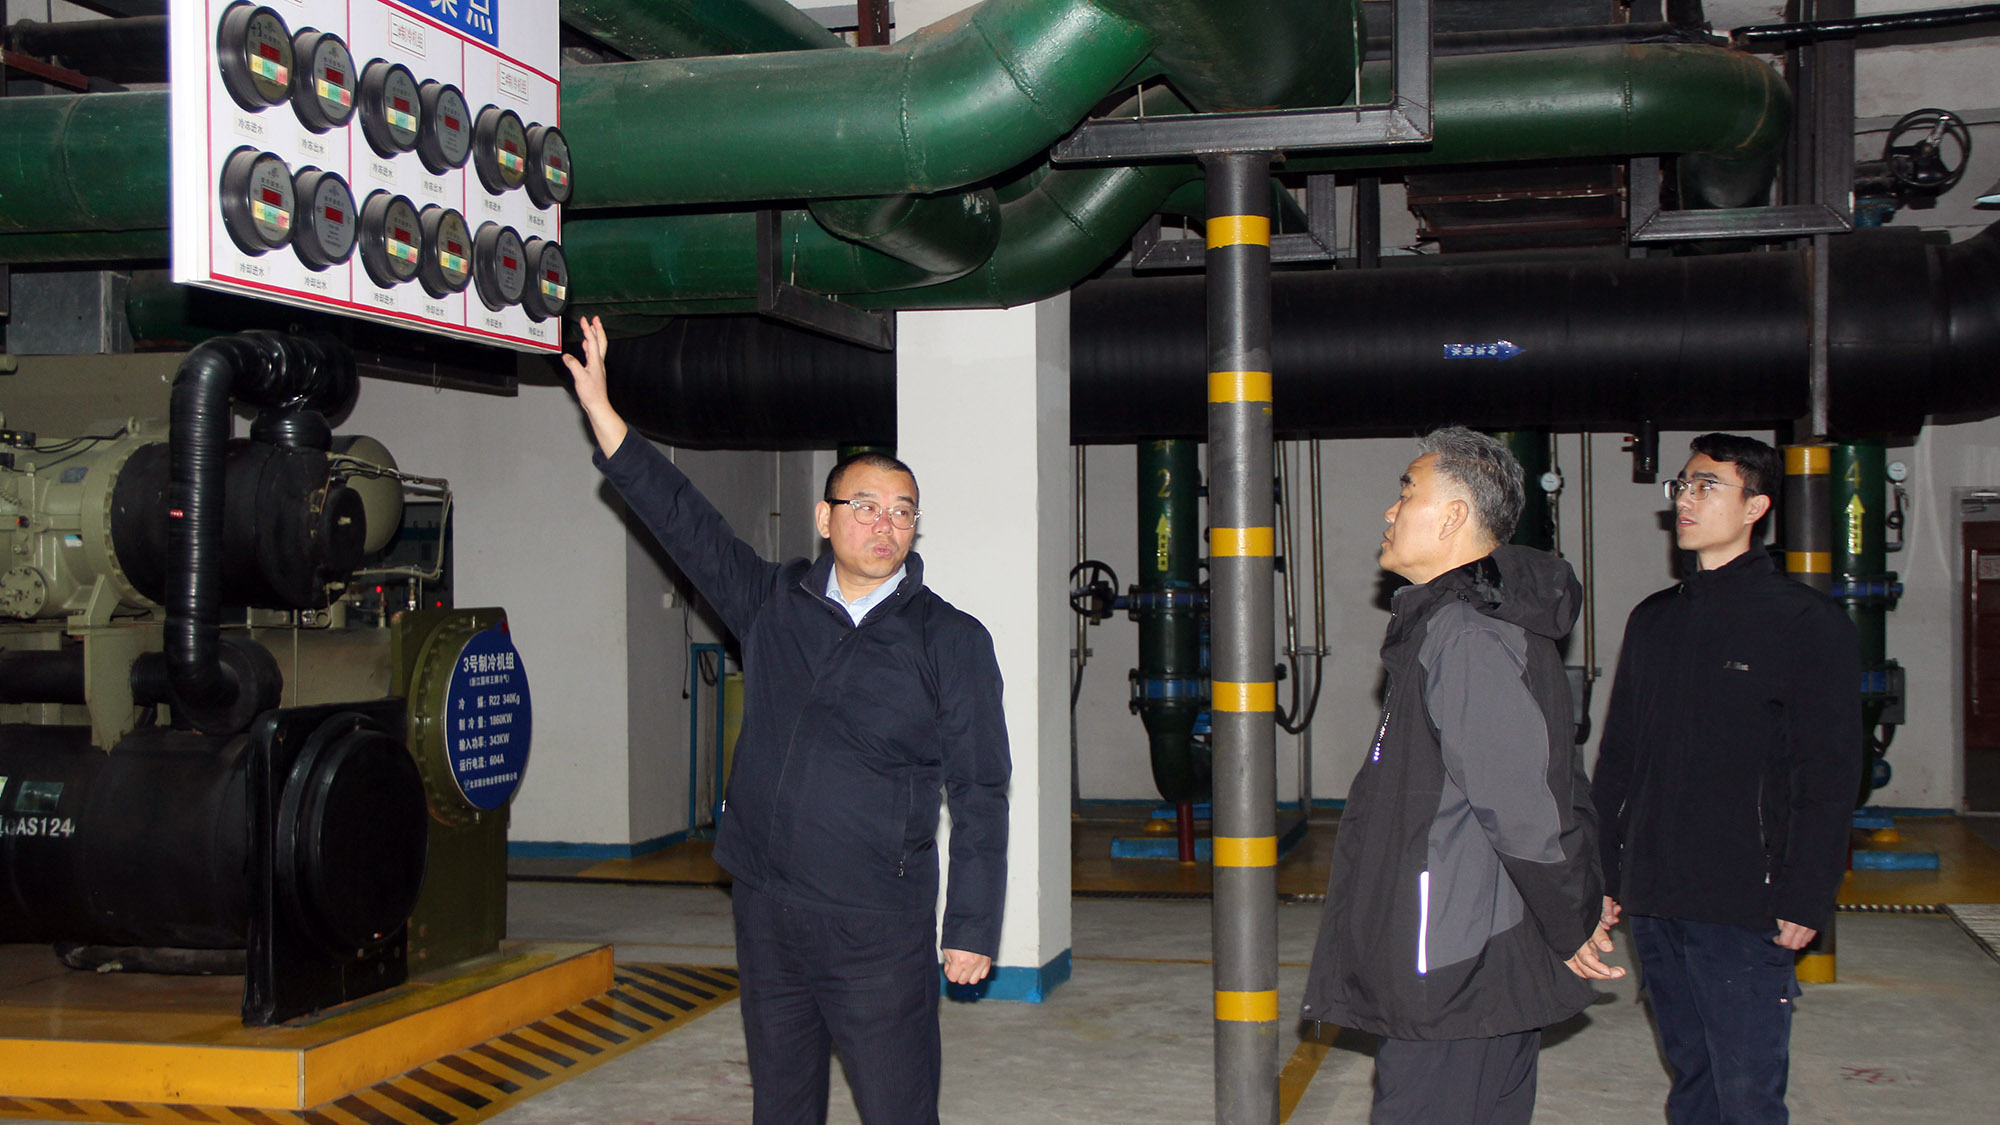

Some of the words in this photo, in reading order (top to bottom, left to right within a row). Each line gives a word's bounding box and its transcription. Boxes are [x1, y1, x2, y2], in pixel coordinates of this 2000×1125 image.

[238, 116, 264, 136] 冷冻进水
[302, 138, 326, 155] 冷冻出水
[1157, 467, 1172, 498] 2
[1843, 460, 1862, 489] 4
[463, 652, 515, 673] 3号制冷机组
[489, 694, 501, 707] R22
